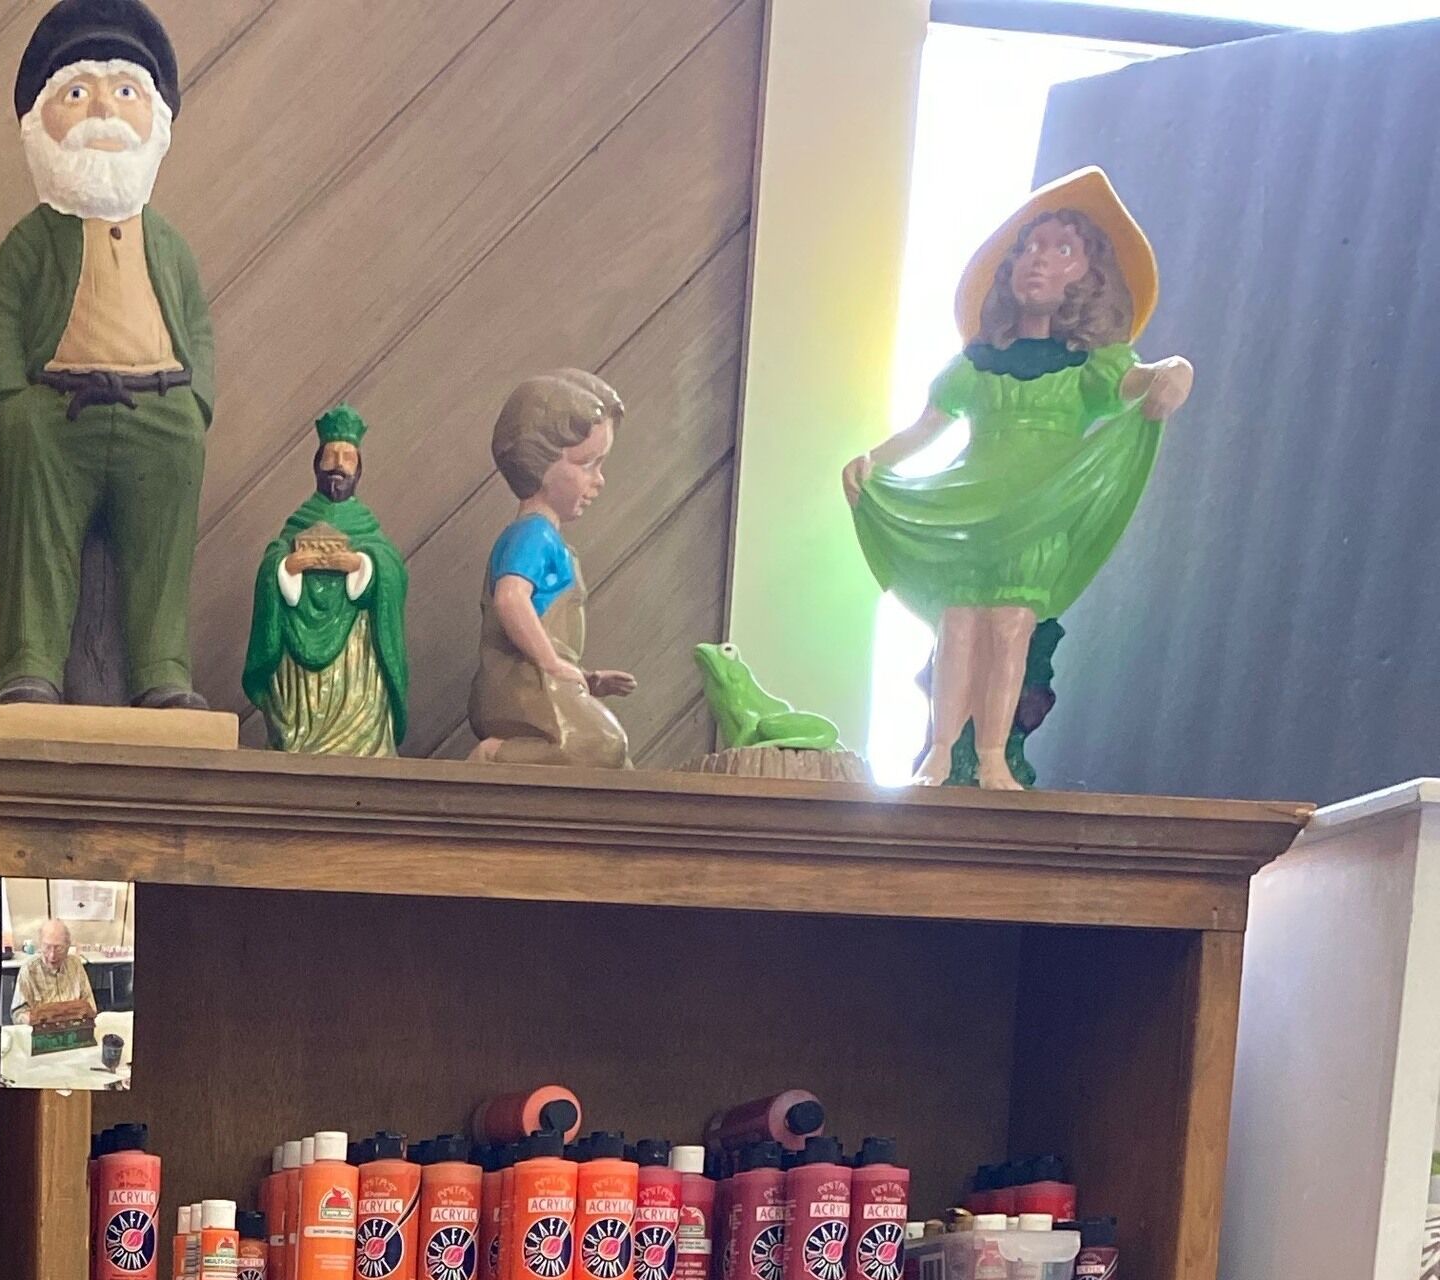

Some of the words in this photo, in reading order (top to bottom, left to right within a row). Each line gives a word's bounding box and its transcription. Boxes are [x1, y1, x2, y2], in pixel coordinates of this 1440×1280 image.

[111, 1192, 156, 1204] ACRYLIC
[361, 1201, 401, 1213] ACRYLIC
[531, 1199, 573, 1212] ACRYLIC
[590, 1201, 632, 1213] ACRYLIC
[867, 1205, 906, 1217] ACRYLIC
[433, 1208, 477, 1221] ACRYLIC
[636, 1210, 678, 1222] ACRYLIC
